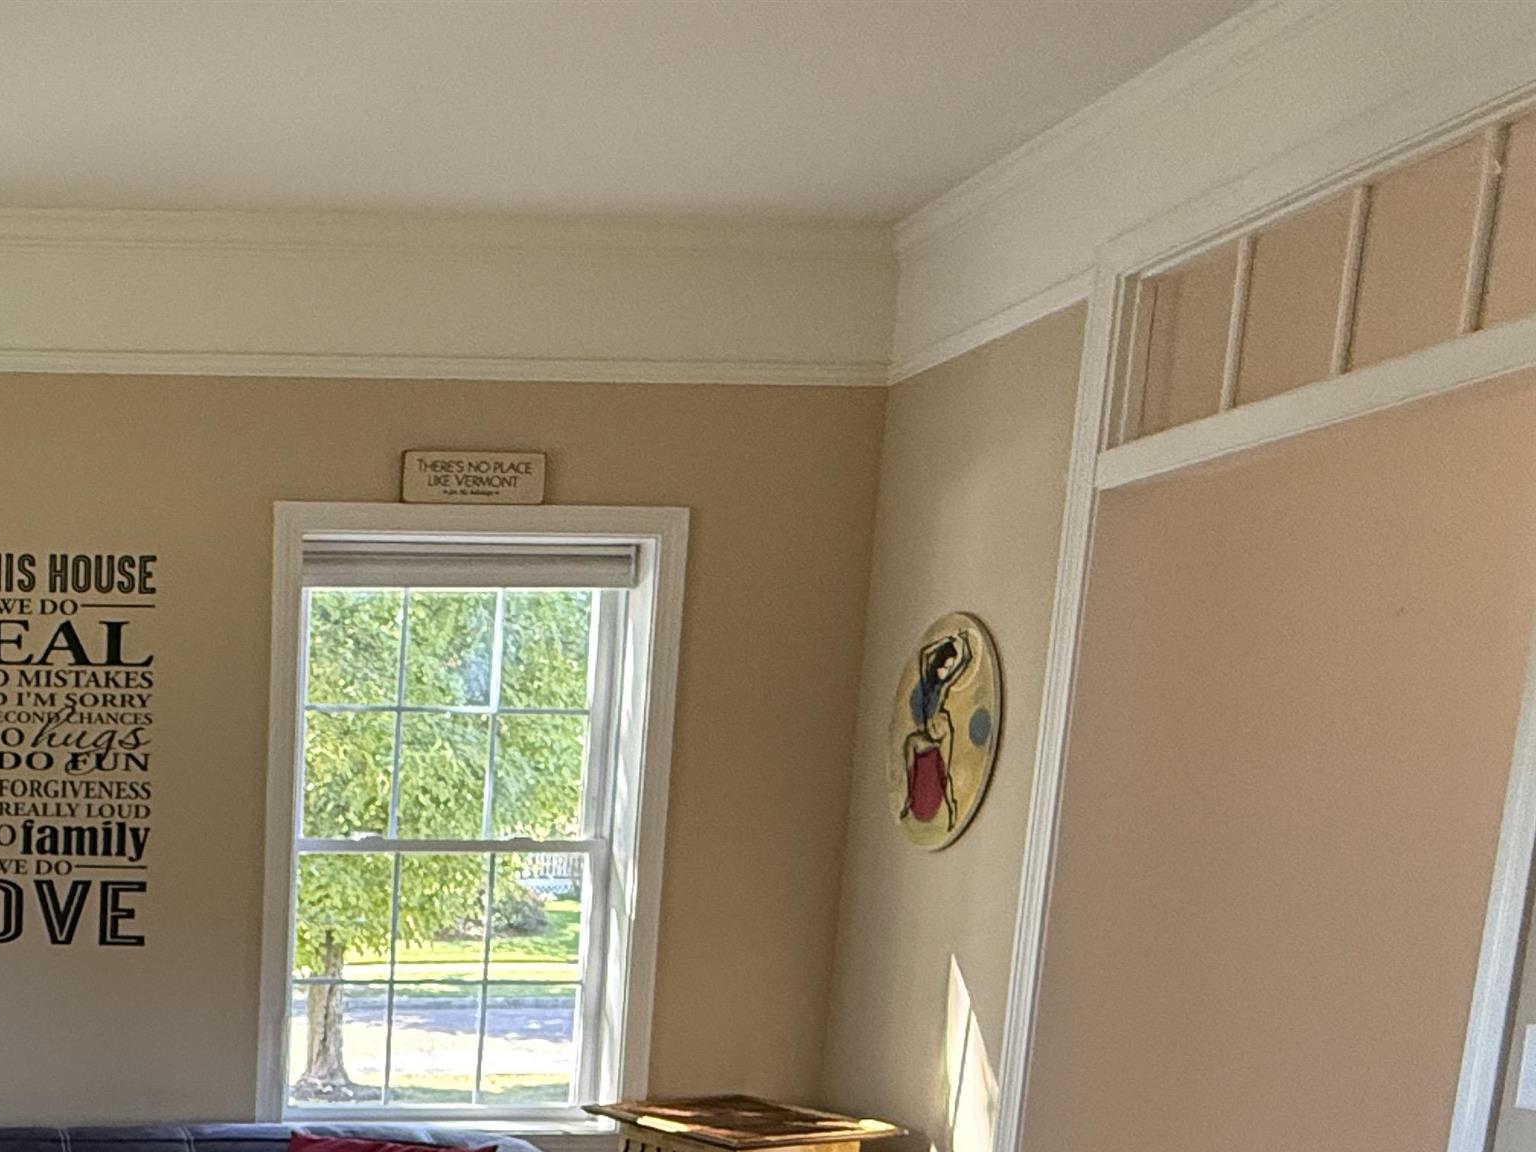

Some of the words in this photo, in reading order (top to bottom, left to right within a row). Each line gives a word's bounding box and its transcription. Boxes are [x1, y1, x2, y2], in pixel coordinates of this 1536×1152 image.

[468, 461, 490, 474] NO
[493, 462, 533, 475] PLACE
[427, 474, 451, 487] LIKE
[454, 474, 519, 488] VERMONT
[49, 554, 157, 594] HOUSE
[40, 599, 79, 616] DO
[17, 669, 154, 689] MISTAKES
[16, 691, 56, 707] I'M
[66, 692, 152, 709] SORRY
[66, 711, 153, 726] CHANCES
[30, 703, 152, 775] hugs
[68, 752, 151, 772] FUN
[86, 803, 151, 819] LOUD
[20, 819, 151, 862] family
[35, 859, 73, 876] DO
